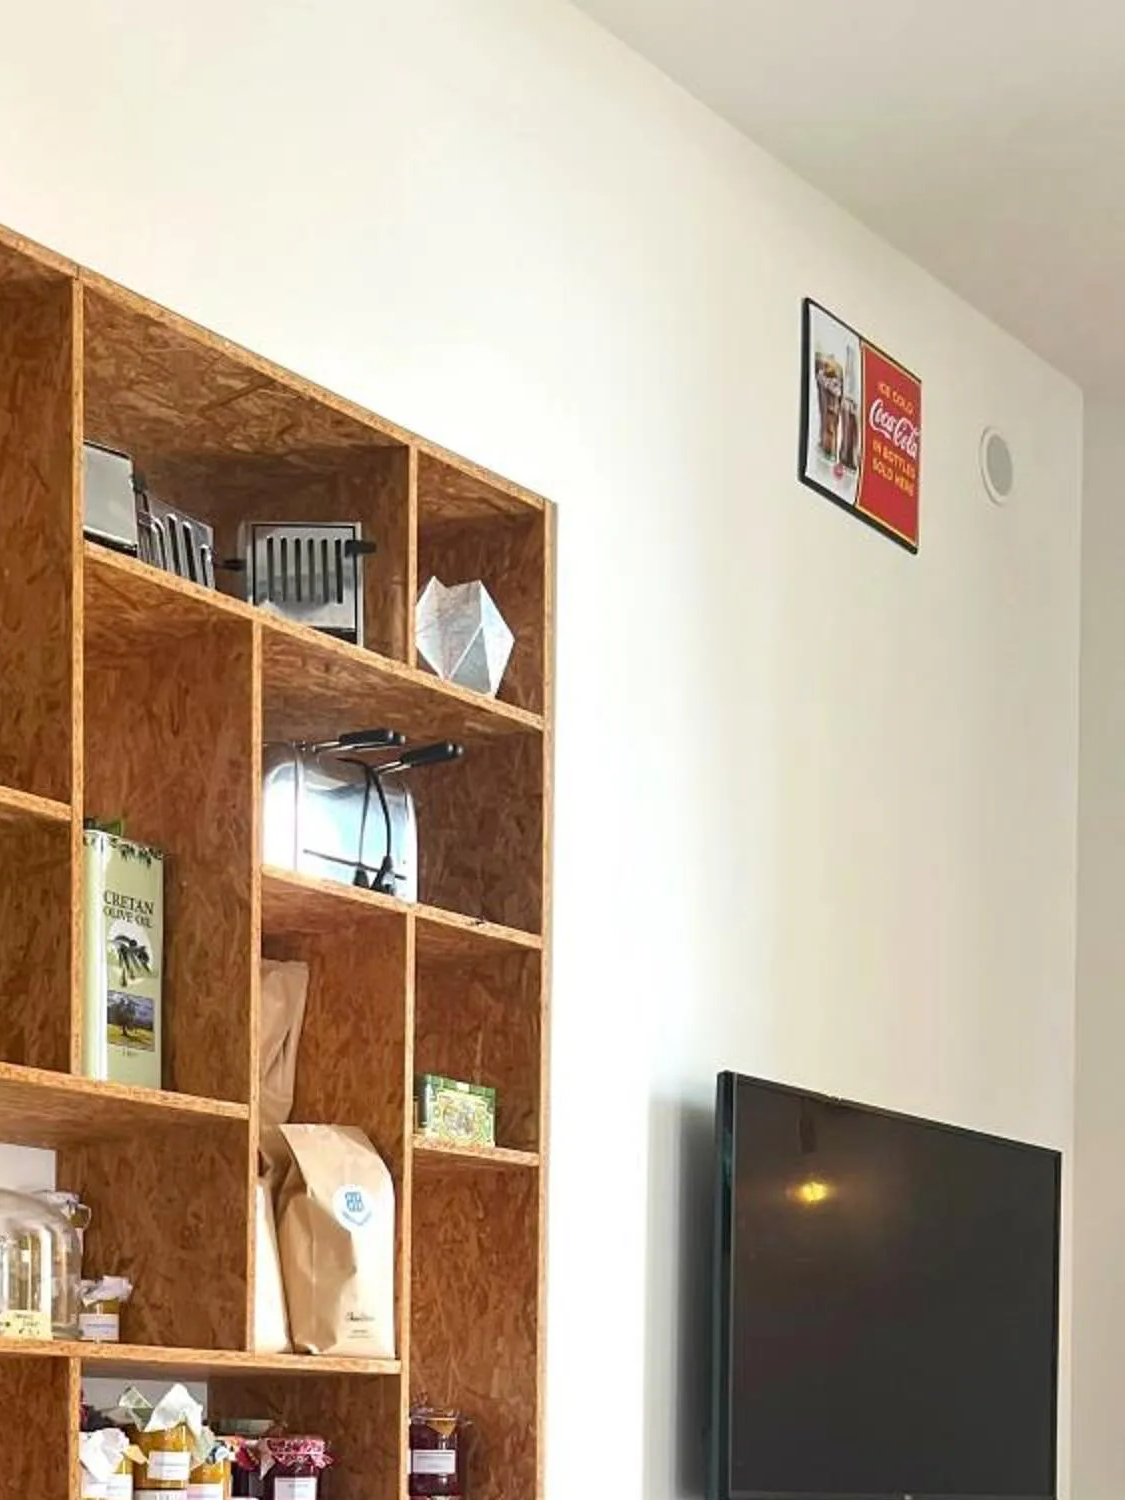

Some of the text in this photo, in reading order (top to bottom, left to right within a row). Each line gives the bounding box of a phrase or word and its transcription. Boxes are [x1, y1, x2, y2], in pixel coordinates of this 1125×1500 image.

[869, 398, 919, 460] Coca-Cola
[103, 889, 154, 915] CRETAN
[103, 905, 153, 929] OLIVE OIL
